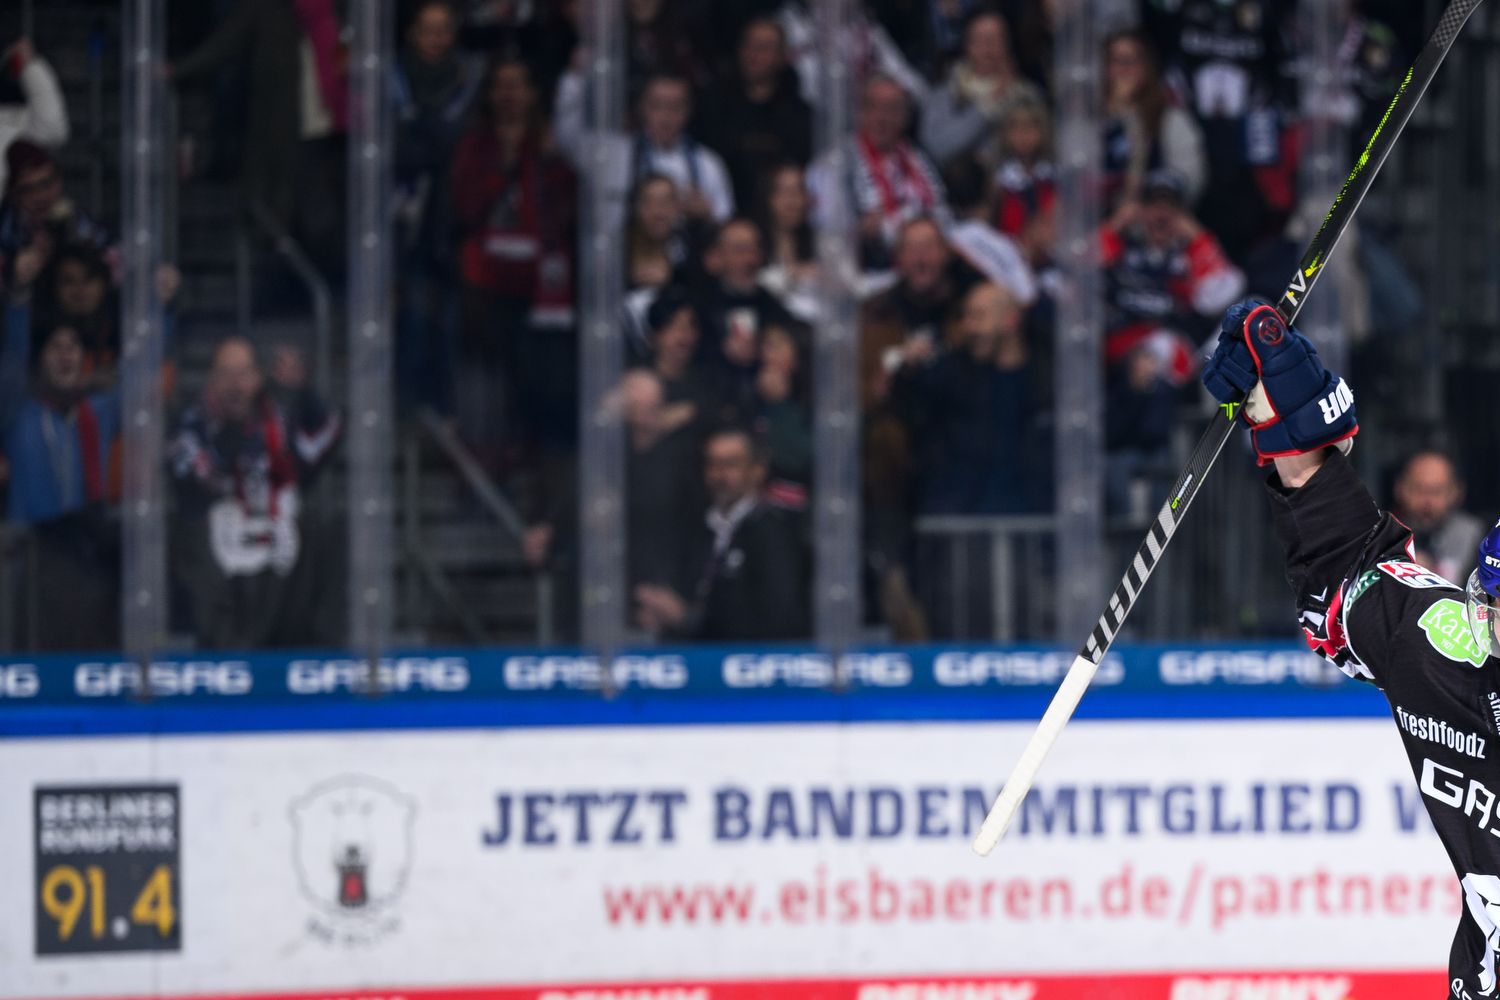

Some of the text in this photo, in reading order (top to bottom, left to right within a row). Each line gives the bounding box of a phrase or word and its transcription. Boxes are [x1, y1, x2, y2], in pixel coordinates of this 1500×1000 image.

[74, 661, 254, 697] GASAG
[287, 658, 470, 695] GASAG
[503, 655, 689, 690] GASAG
[722, 653, 913, 688] GASAG
[1396, 705, 1486, 760] freshfoodz
[480, 789, 688, 848] JETZT
[42, 863, 176, 942] 91.4
